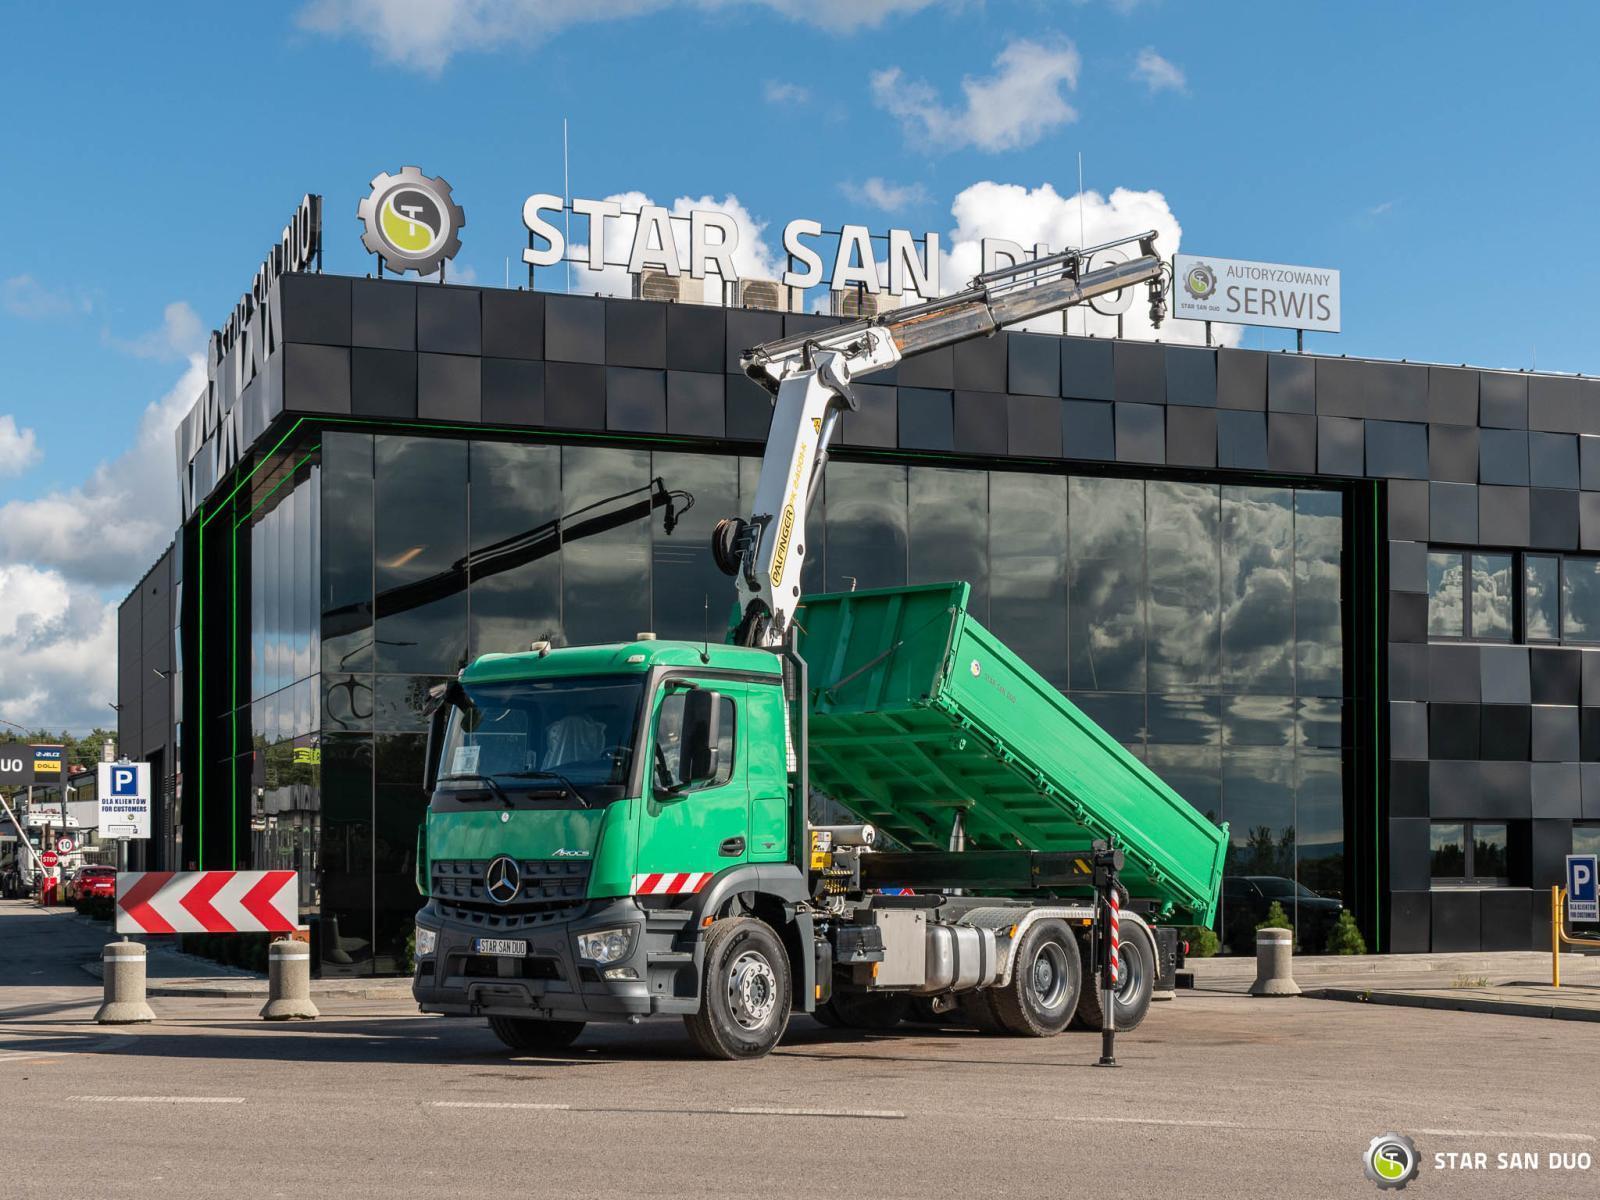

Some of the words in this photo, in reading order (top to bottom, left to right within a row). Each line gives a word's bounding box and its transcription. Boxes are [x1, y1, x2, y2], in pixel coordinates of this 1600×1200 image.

[522, 193, 739, 282] STAR
[782, 219, 940, 299] SAN
[1226, 265, 1330, 287] AUTORYZOWANY
[1226, 285, 1331, 321] SERWIS
[772, 510, 793, 583] PALFINGER
[116, 770, 133, 792] P
[61, 840, 70, 850] 10
[1574, 864, 1590, 896] P
[481, 940, 497, 952] STAR
[499, 940, 510, 952] SAN
[512, 941, 525, 953] DUO
